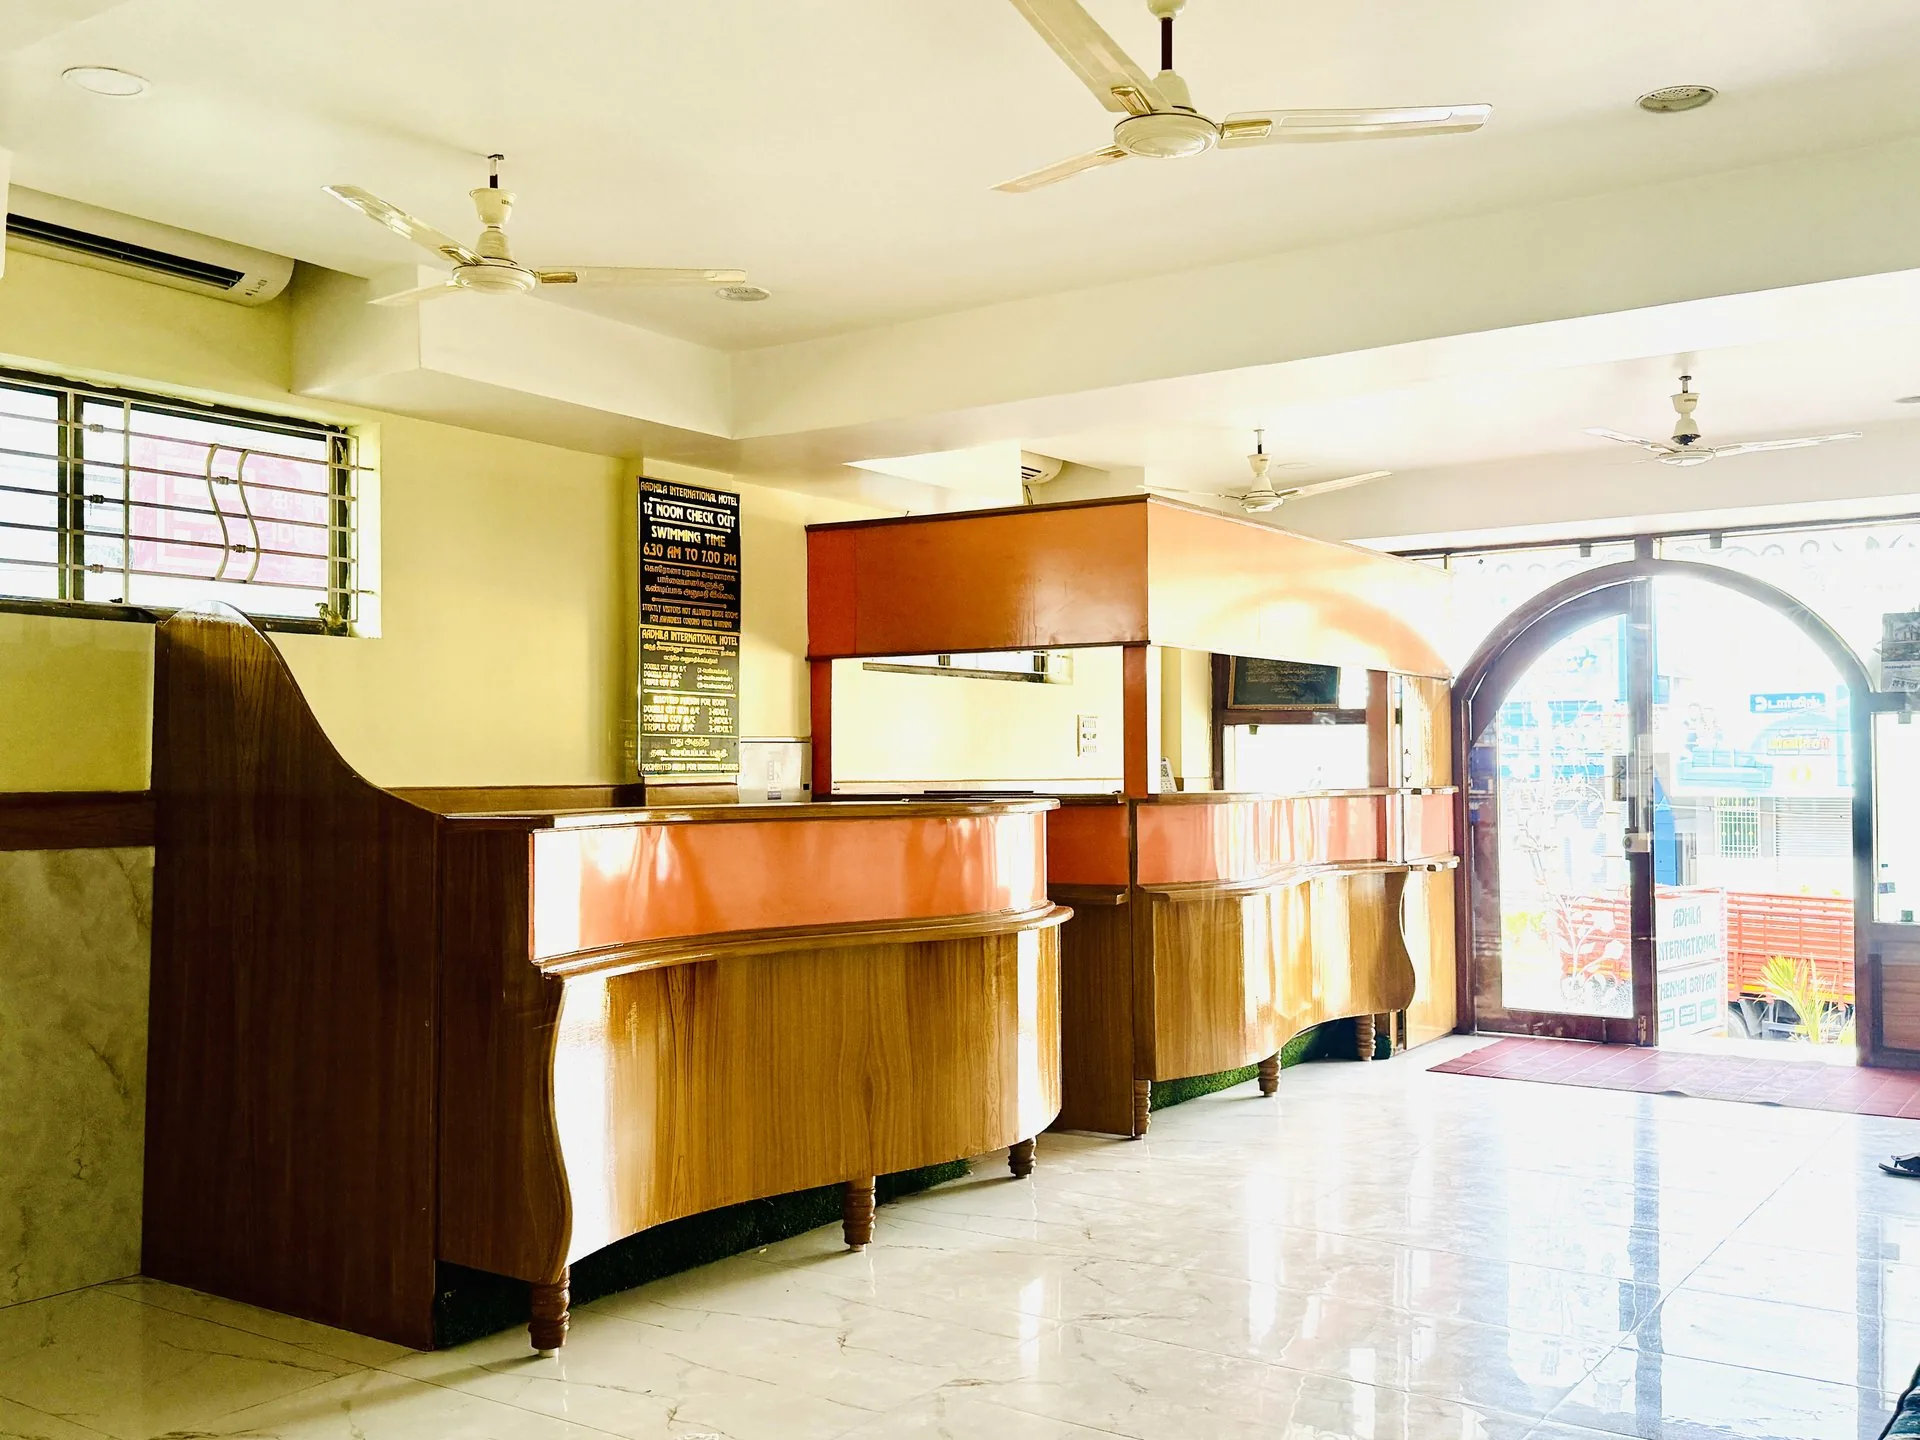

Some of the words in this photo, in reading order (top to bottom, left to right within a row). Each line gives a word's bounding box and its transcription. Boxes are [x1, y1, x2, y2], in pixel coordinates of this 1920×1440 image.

[669, 485, 717, 503] INTERNATIONAL
[718, 494, 738, 507] HOTEL
[643, 501, 653, 515] 12
[656, 503, 684, 520] NOON
[686, 508, 714, 524] CHECK
[717, 513, 736, 528] OUT
[651, 525, 701, 544] SWIMMING
[704, 533, 726, 548] TIME
[667, 545, 682, 560] AM
[685, 547, 699, 562] TO
[701, 549, 721, 564] 7.00
[723, 552, 737, 566] PM
[670, 631, 718, 645] INTERNATIONAL
[719, 635, 738, 647] HOTEL
[1657, 933, 1718, 962] NTERNATIONAL
[1658, 977, 1688, 1001] HENNAI
